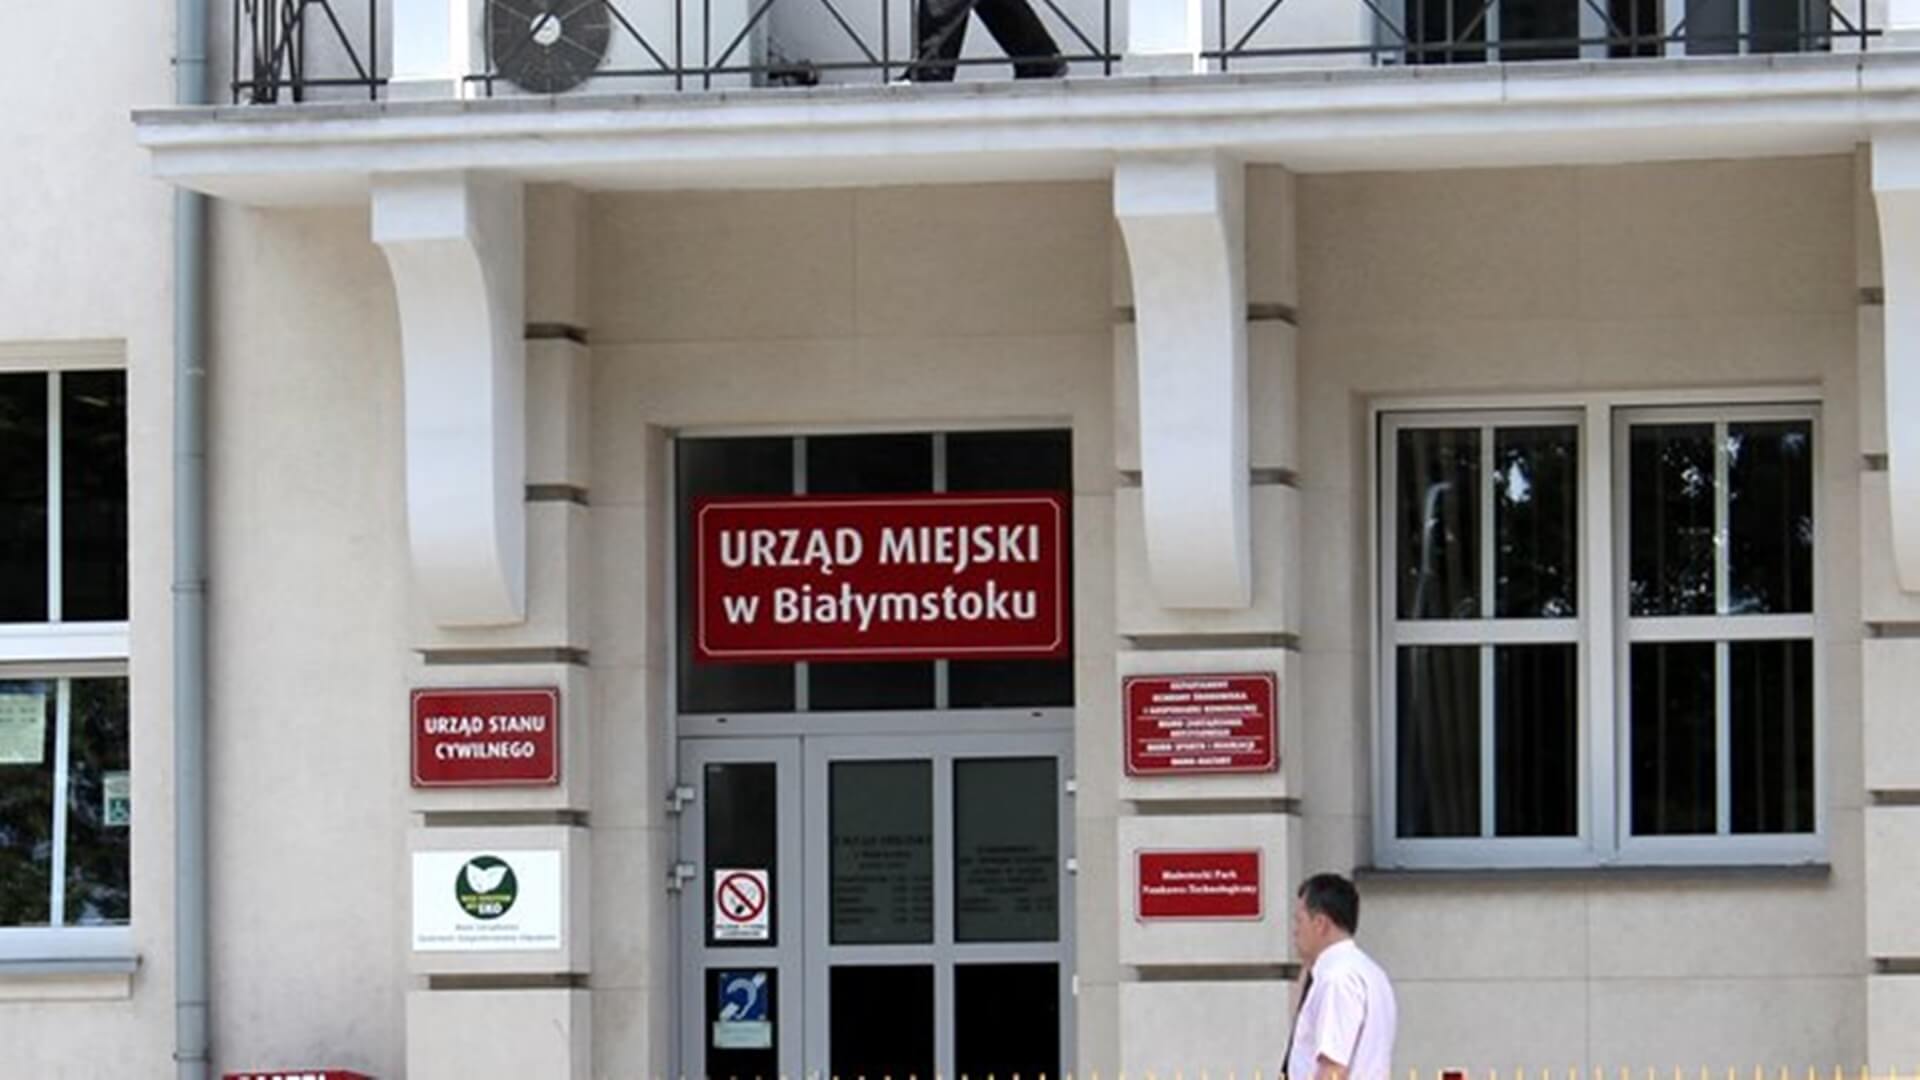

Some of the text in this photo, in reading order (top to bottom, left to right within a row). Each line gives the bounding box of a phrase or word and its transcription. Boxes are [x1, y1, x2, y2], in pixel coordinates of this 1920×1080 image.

[719, 524, 1040, 574] URZĄD MIEJSKI
[723, 580, 1037, 632] w Białymstoku
[424, 715, 545, 737] URZĄD STANU
[435, 741, 536, 760] CYWILNEGO
